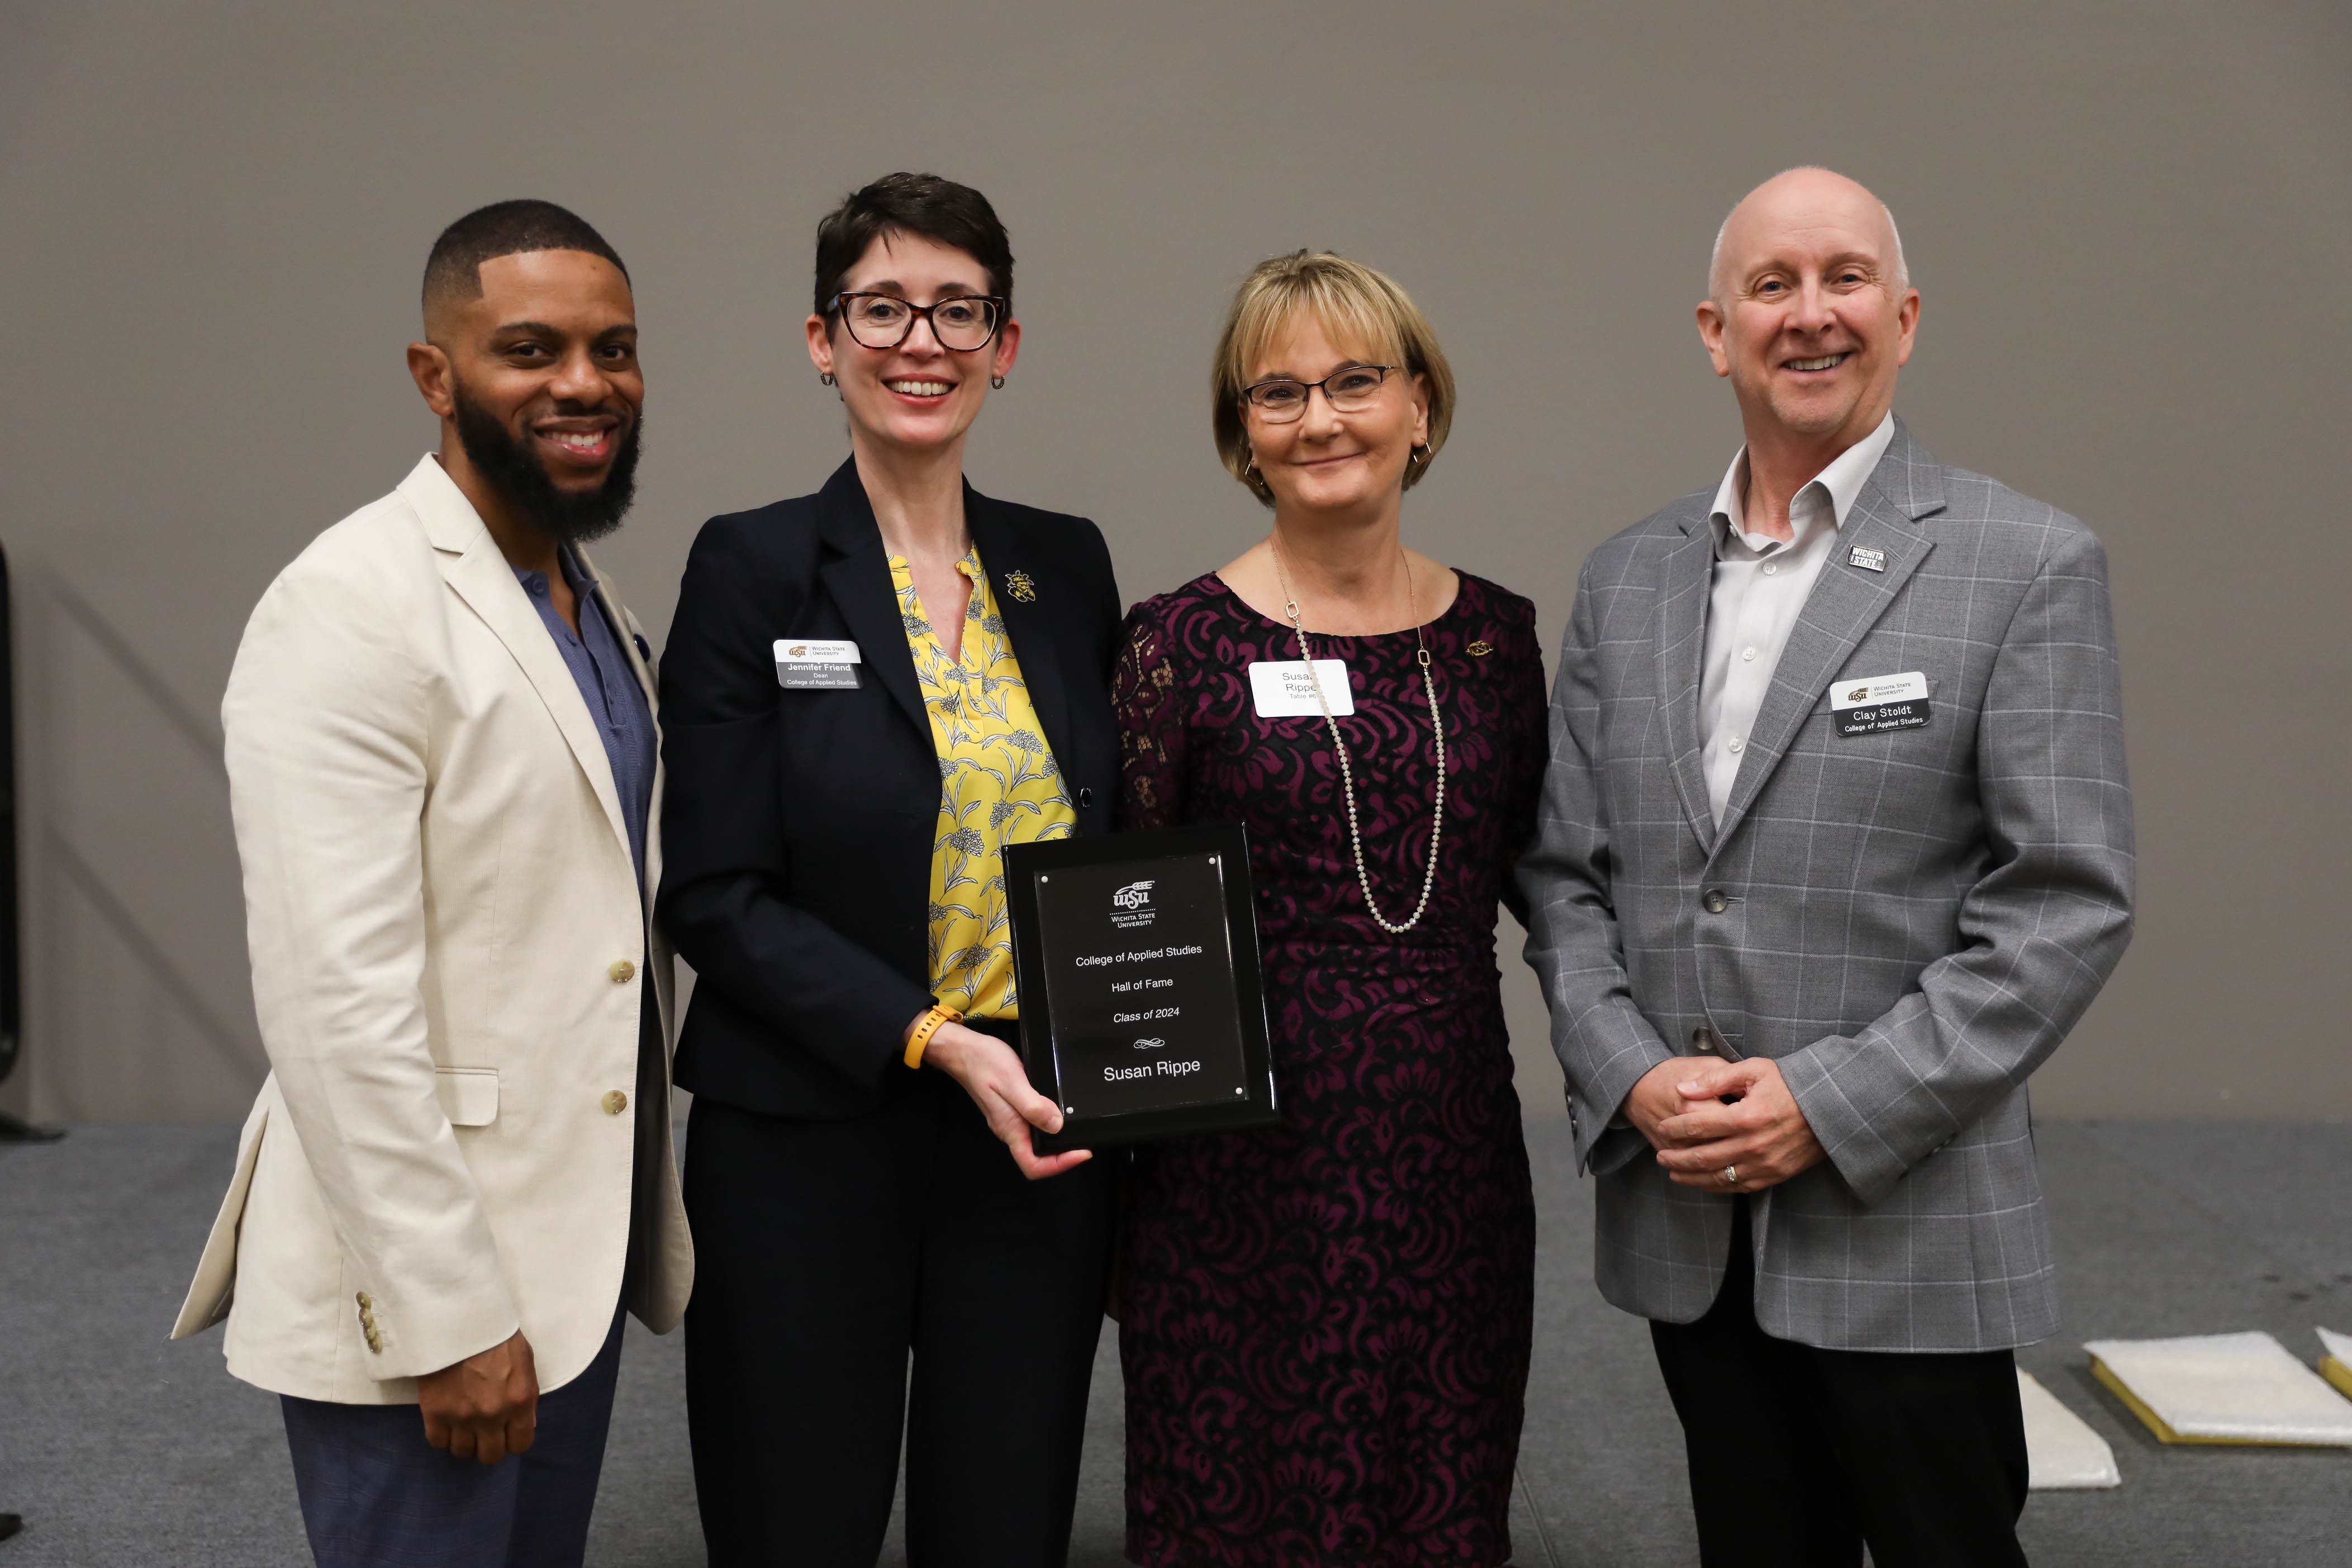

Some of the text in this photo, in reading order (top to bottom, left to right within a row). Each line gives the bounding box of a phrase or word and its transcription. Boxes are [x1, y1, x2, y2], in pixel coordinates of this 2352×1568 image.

[1852, 547, 1884, 561] WICHITA
[1854, 555, 1877, 568] STATE
[1853, 705, 1912, 721] Clay Stoldt
[1877, 720, 1899, 729] Applied
[1900, 717, 1923, 725] Studies
[1076, 945, 1202, 966] College of Applied Studies
[1112, 979, 1173, 992] Hall of Fame
[1114, 1007, 1180, 1023] Class of 2024
[1104, 1061, 1200, 1081] Susan Rippe
